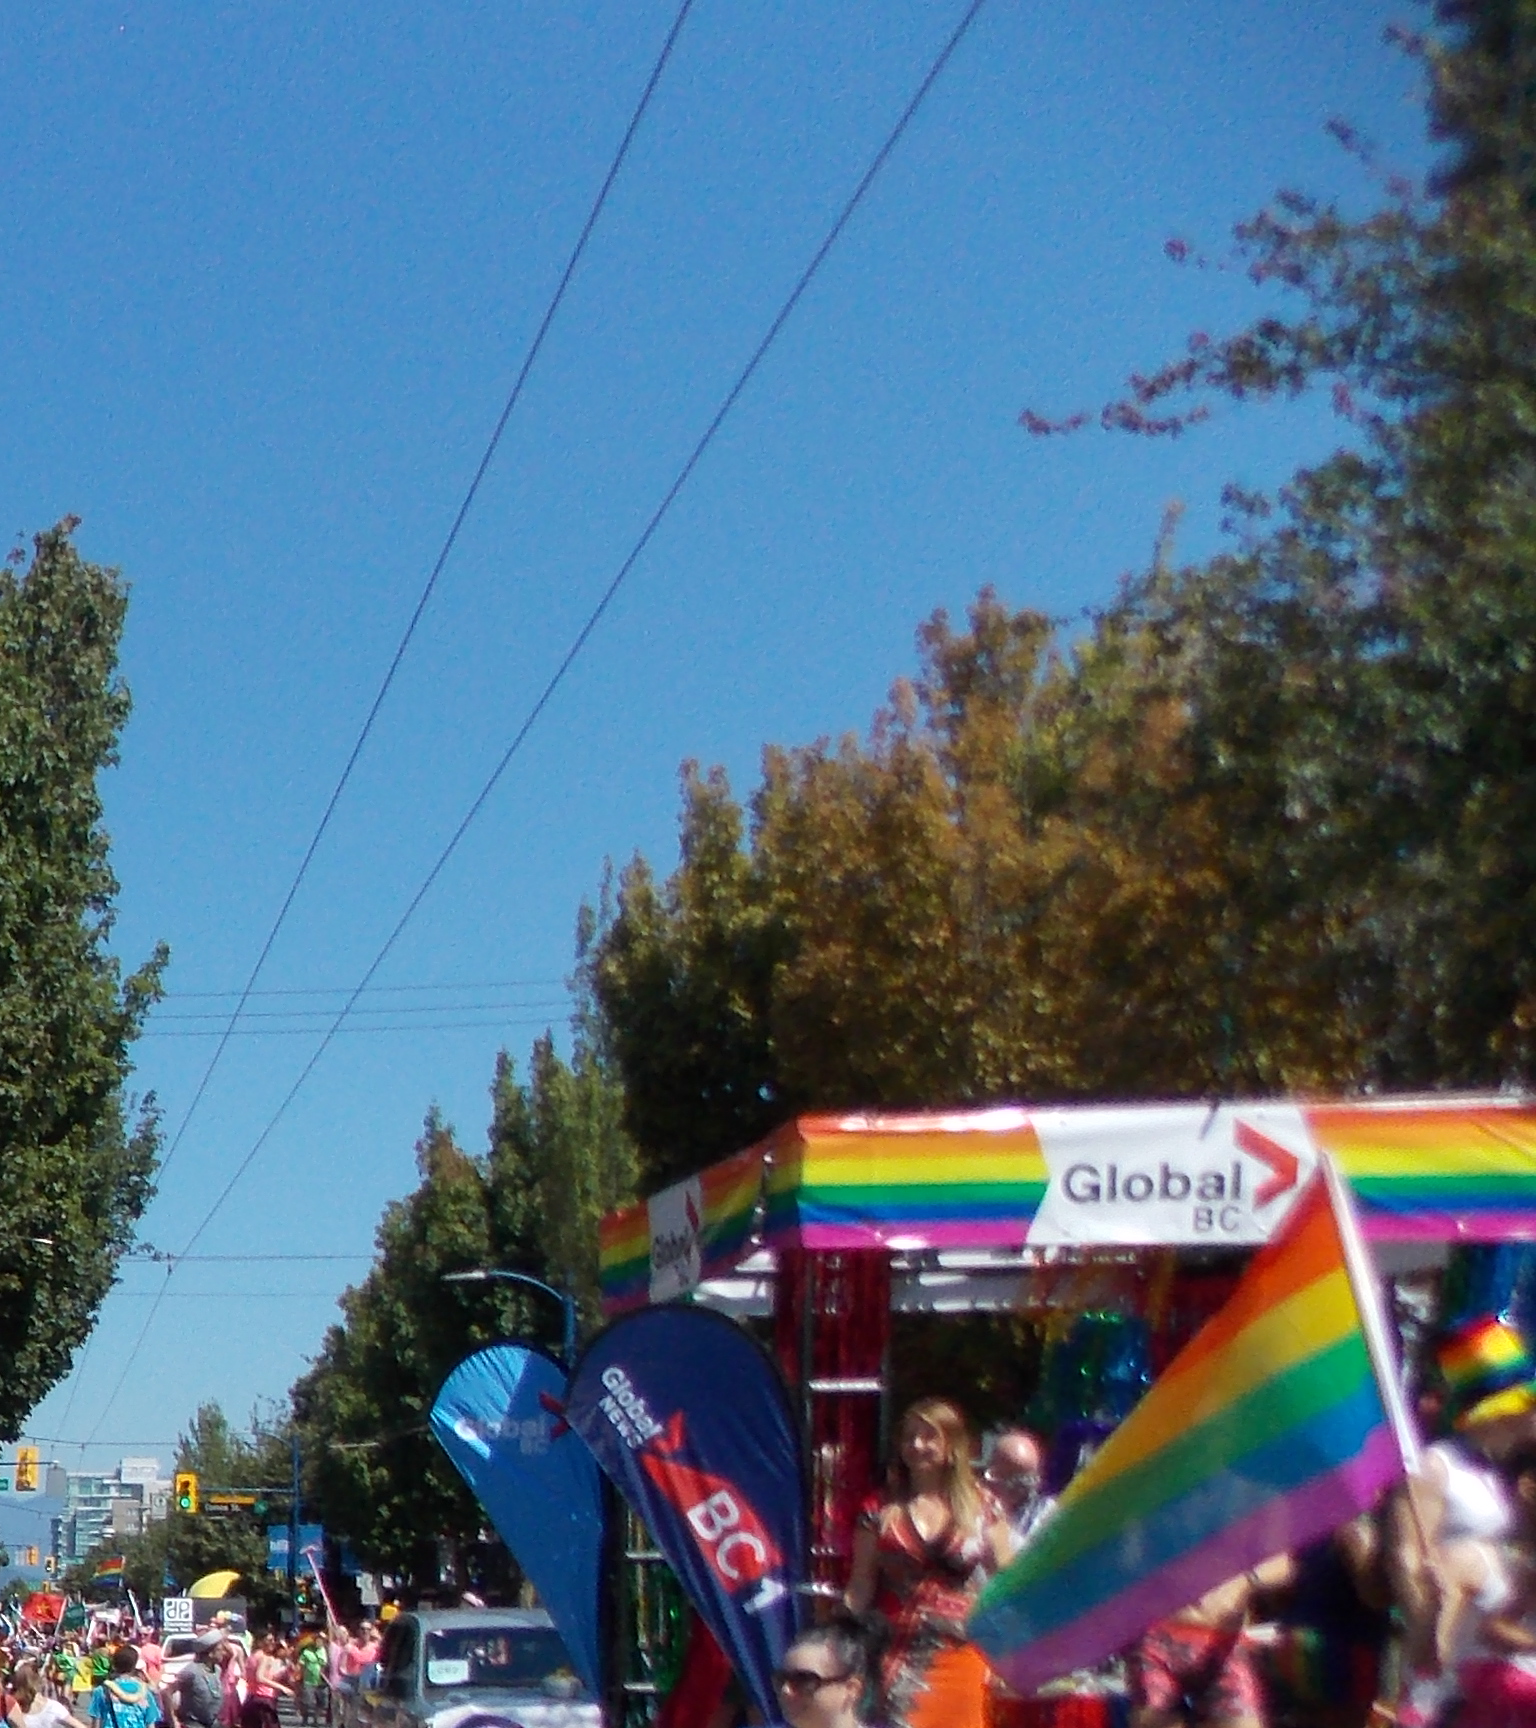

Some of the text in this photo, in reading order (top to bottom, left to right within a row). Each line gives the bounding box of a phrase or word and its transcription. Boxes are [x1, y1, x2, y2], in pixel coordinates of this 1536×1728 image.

[1061, 1159, 1242, 1204] Global
[1192, 1205, 1241, 1233] BC
[599, 1394, 644, 1449] NEWS
[602, 1366, 663, 1440] Global
[687, 1490, 785, 1614] BC 1
